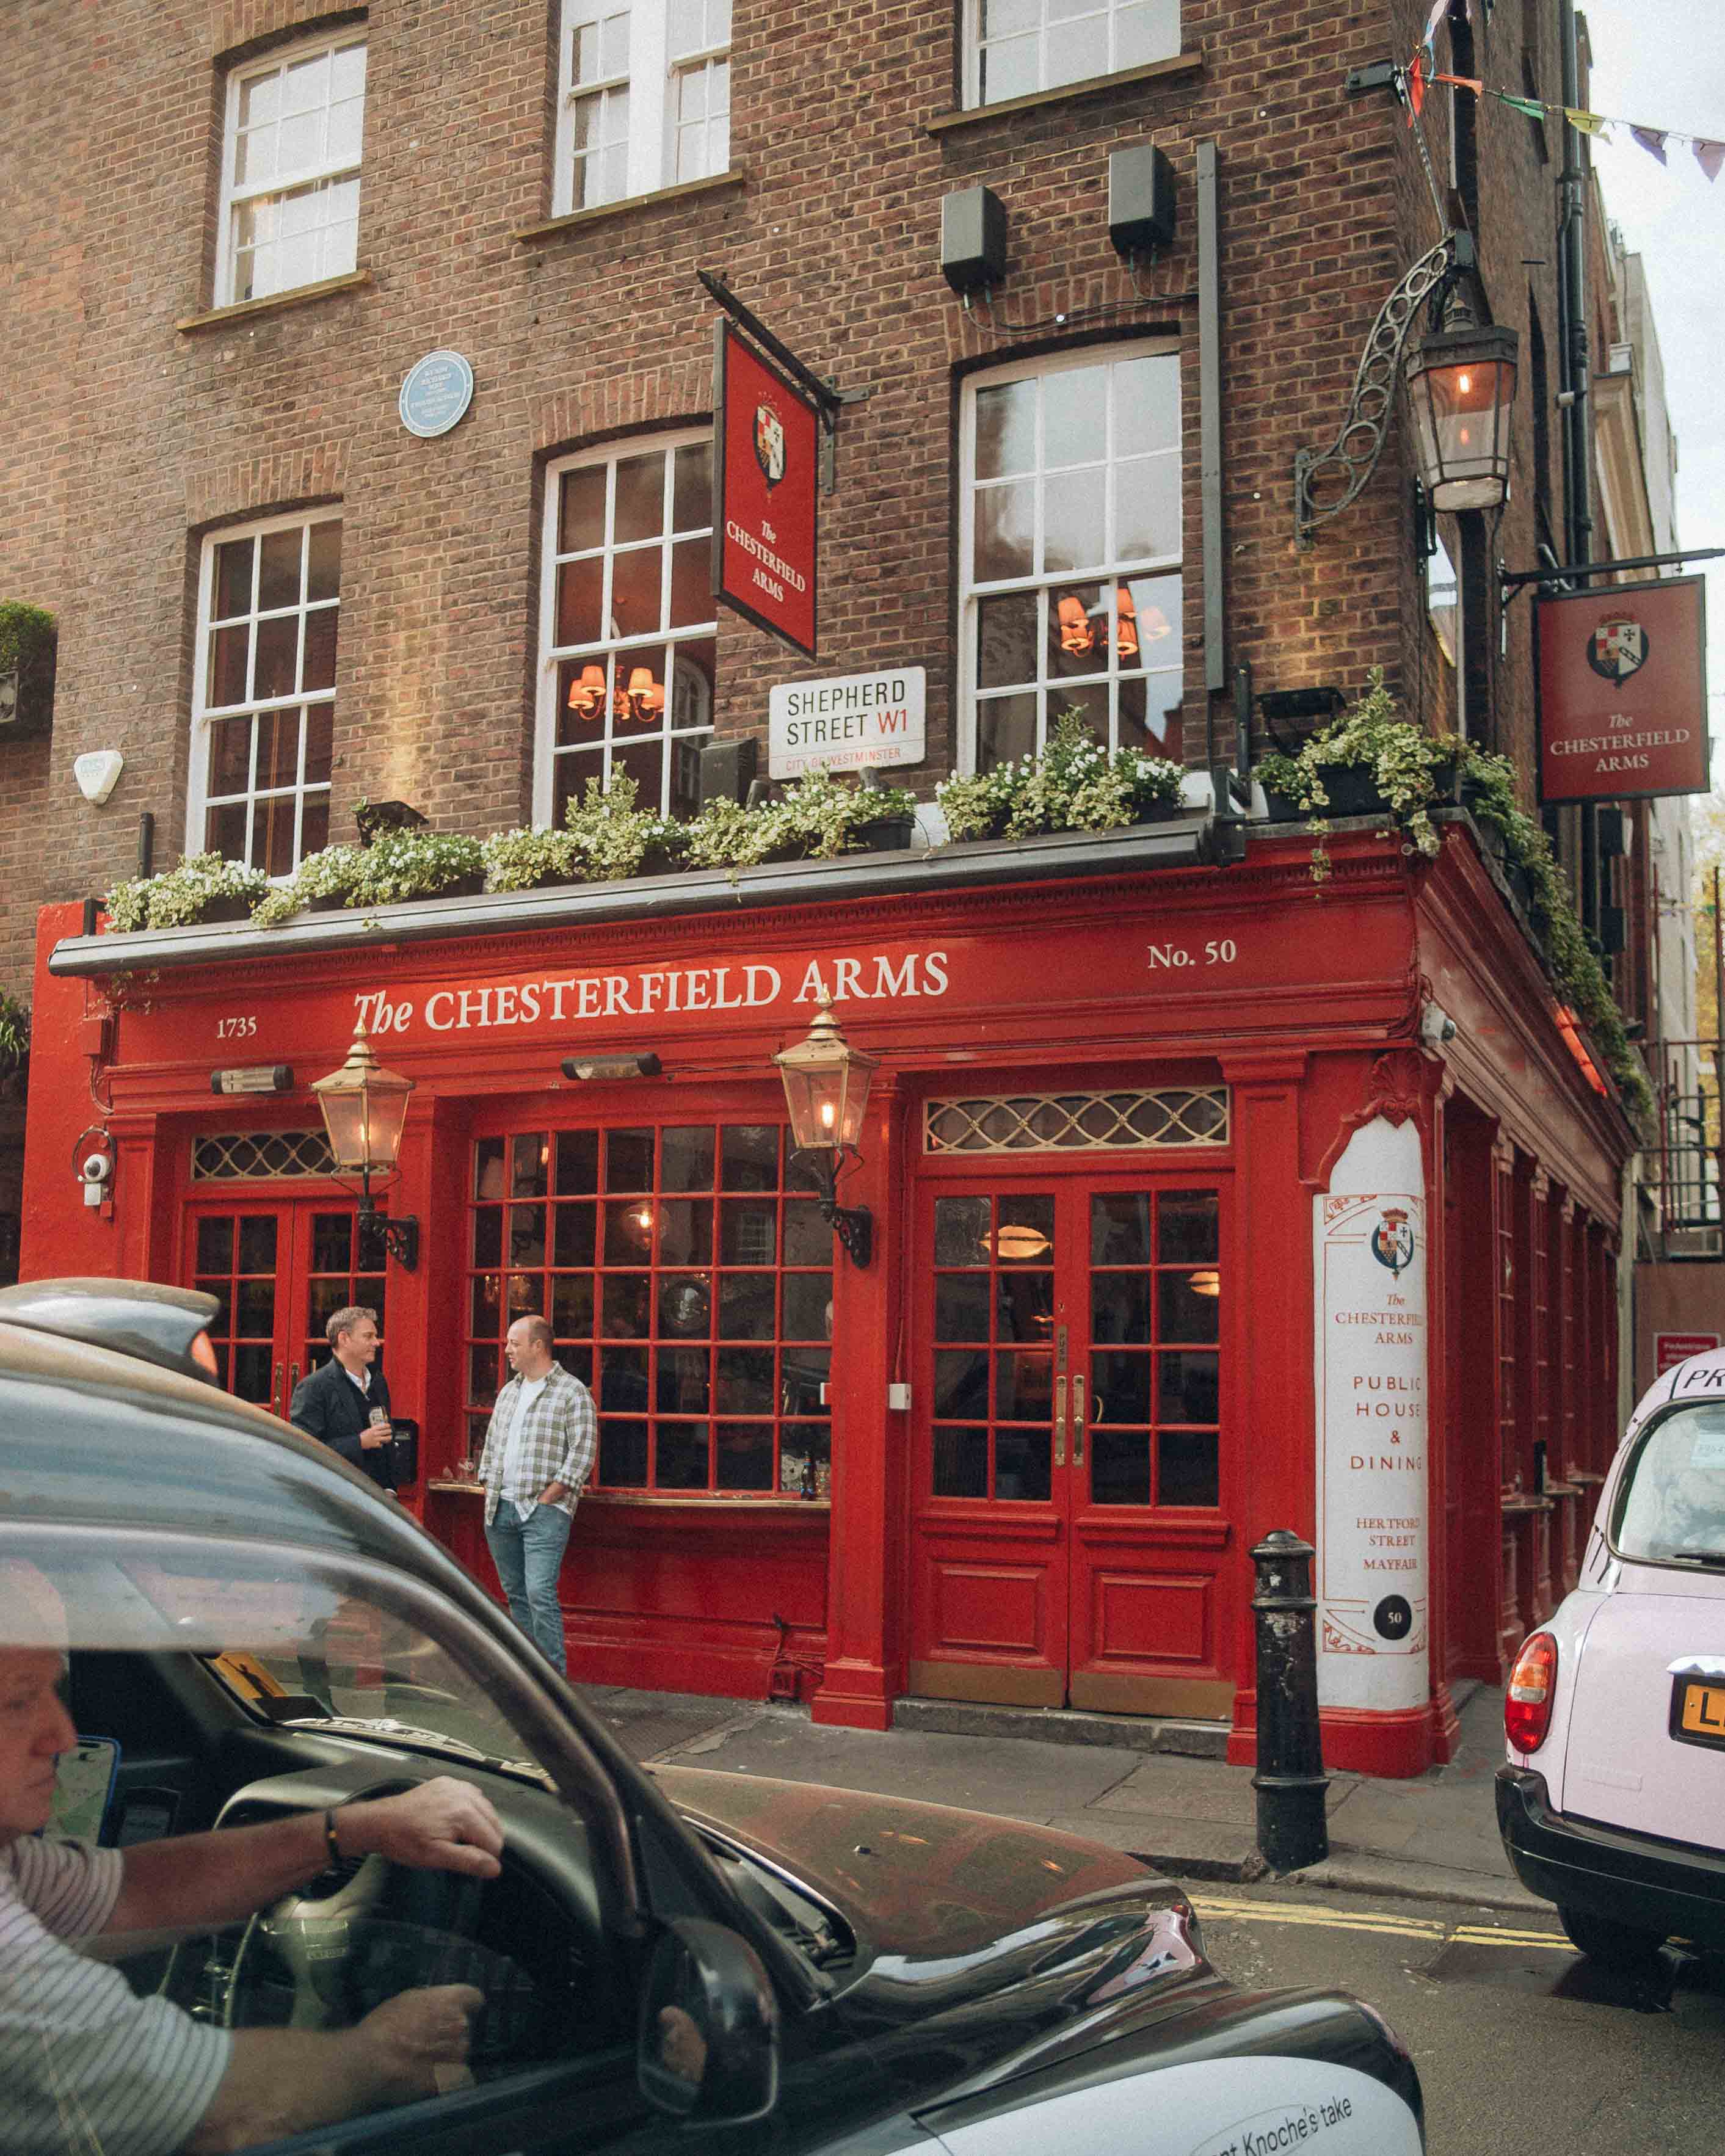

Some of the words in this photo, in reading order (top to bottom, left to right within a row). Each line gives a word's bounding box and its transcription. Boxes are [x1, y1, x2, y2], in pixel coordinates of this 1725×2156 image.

[761, 520, 777, 544] The
[726, 520, 806, 592] CHESTERFIELD
[752, 567, 784, 603] ARMS
[788, 680, 905, 716] SHEPHERD
[787, 713, 868, 745] STREET
[878, 708, 908, 734] W1
[1608, 713, 1633, 729] The
[1550, 728, 1691, 756] CHESTERFIELD
[830, 747, 901, 765] WESTMINSTER
[1594, 753, 1650, 772] ARMS
[1146, 943, 1196, 969] No.
[1205, 939, 1237, 965] 50
[354, 989, 413, 1034] The
[424, 965, 782, 1031] CHESTERFIELD
[792, 951, 949, 1003] ARMS
[216, 1015, 257, 1039] 1735
[1387, 1293, 1407, 1306] The
[1375, 1332, 1413, 1344] ARMS
[1353, 1376, 1422, 1391] PUBLIC
[1683, 1368, 1725, 1389] PR
[1356, 1403, 1420, 1417] HOUSE
[1390, 1429, 1401, 1444] &
[1351, 1455, 1422, 1470] DINING
[1368, 1534, 1416, 1547] STREET
[1387, 1611, 1403, 1624] 50
[1699, 1691, 1725, 1727] L
[1242, 2107, 1318, 2156] Knoche's
[1320, 2096, 1353, 2127] take
